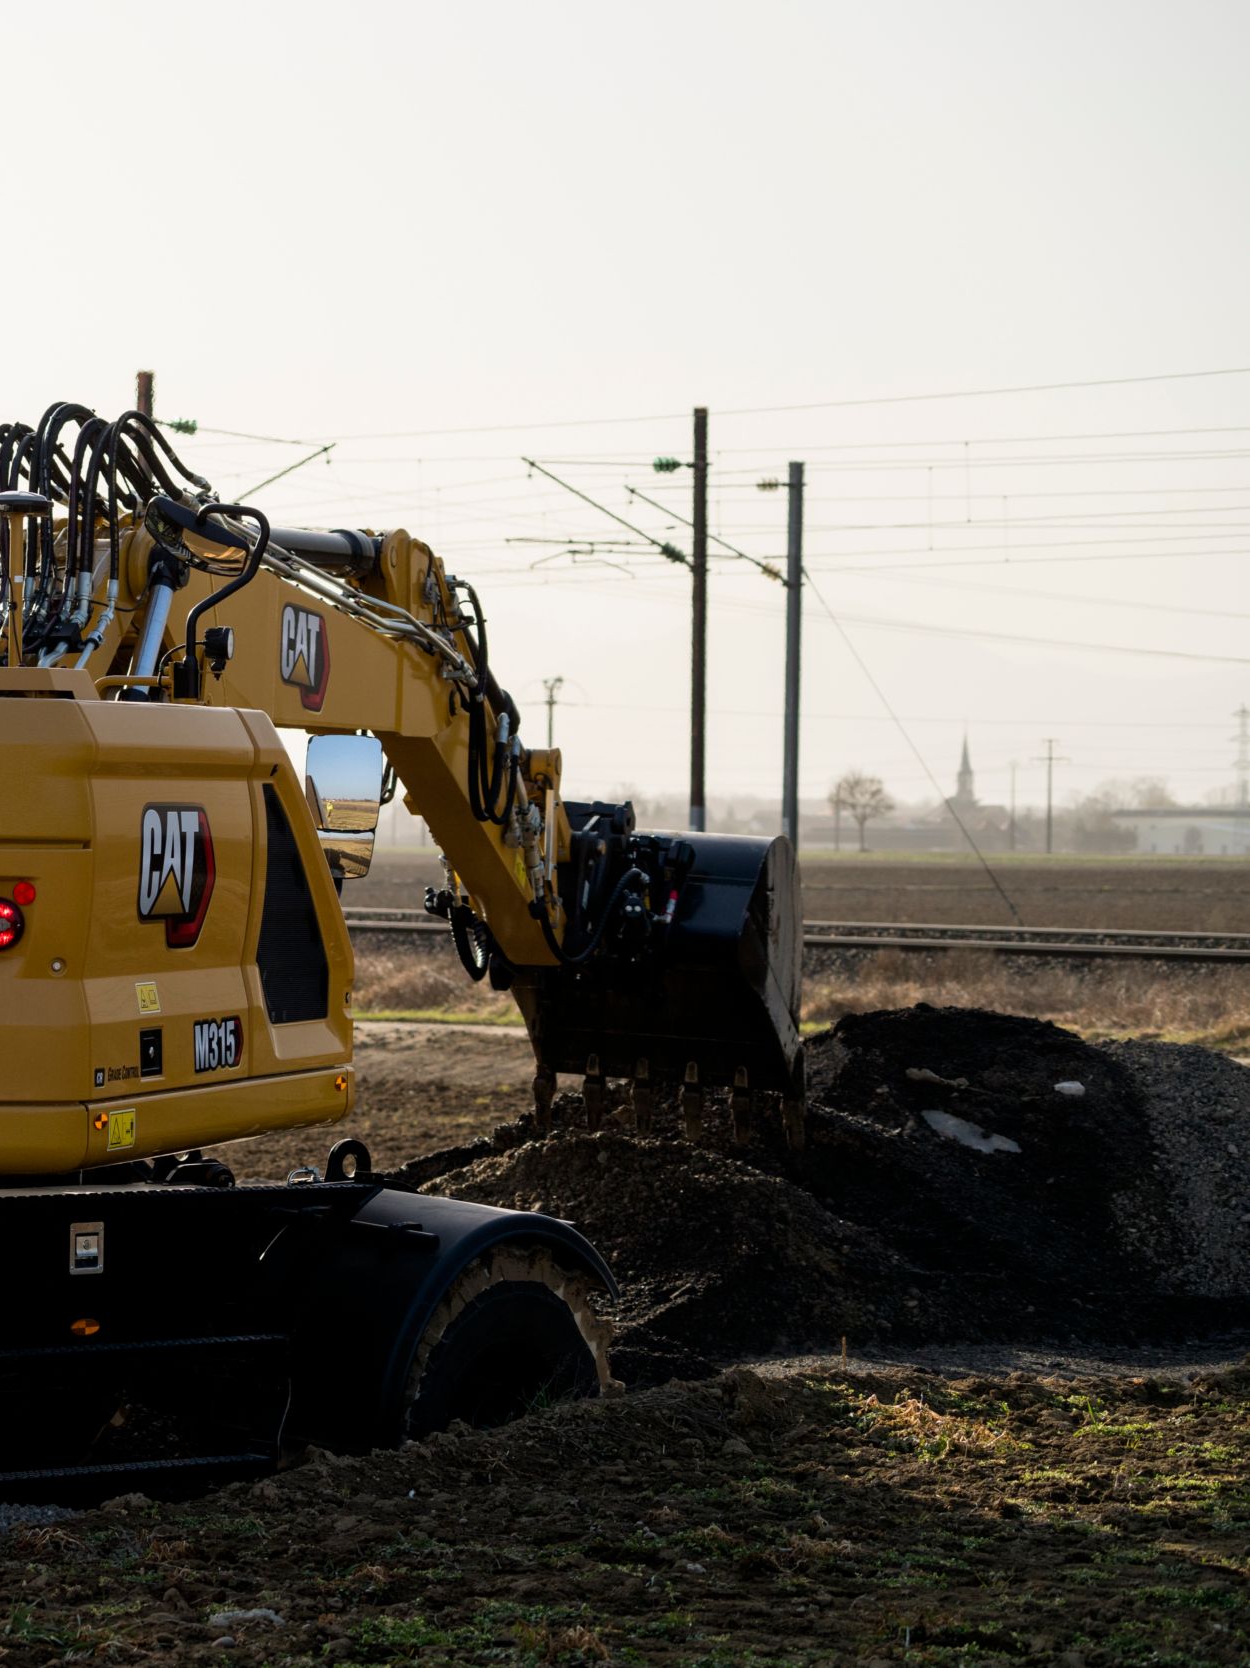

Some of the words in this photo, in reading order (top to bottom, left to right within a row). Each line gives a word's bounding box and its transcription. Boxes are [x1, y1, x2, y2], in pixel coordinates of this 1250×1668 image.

[282, 606, 320, 687] CAT
[139, 809, 200, 915] CAT
[194, 1020, 236, 1070] M315
